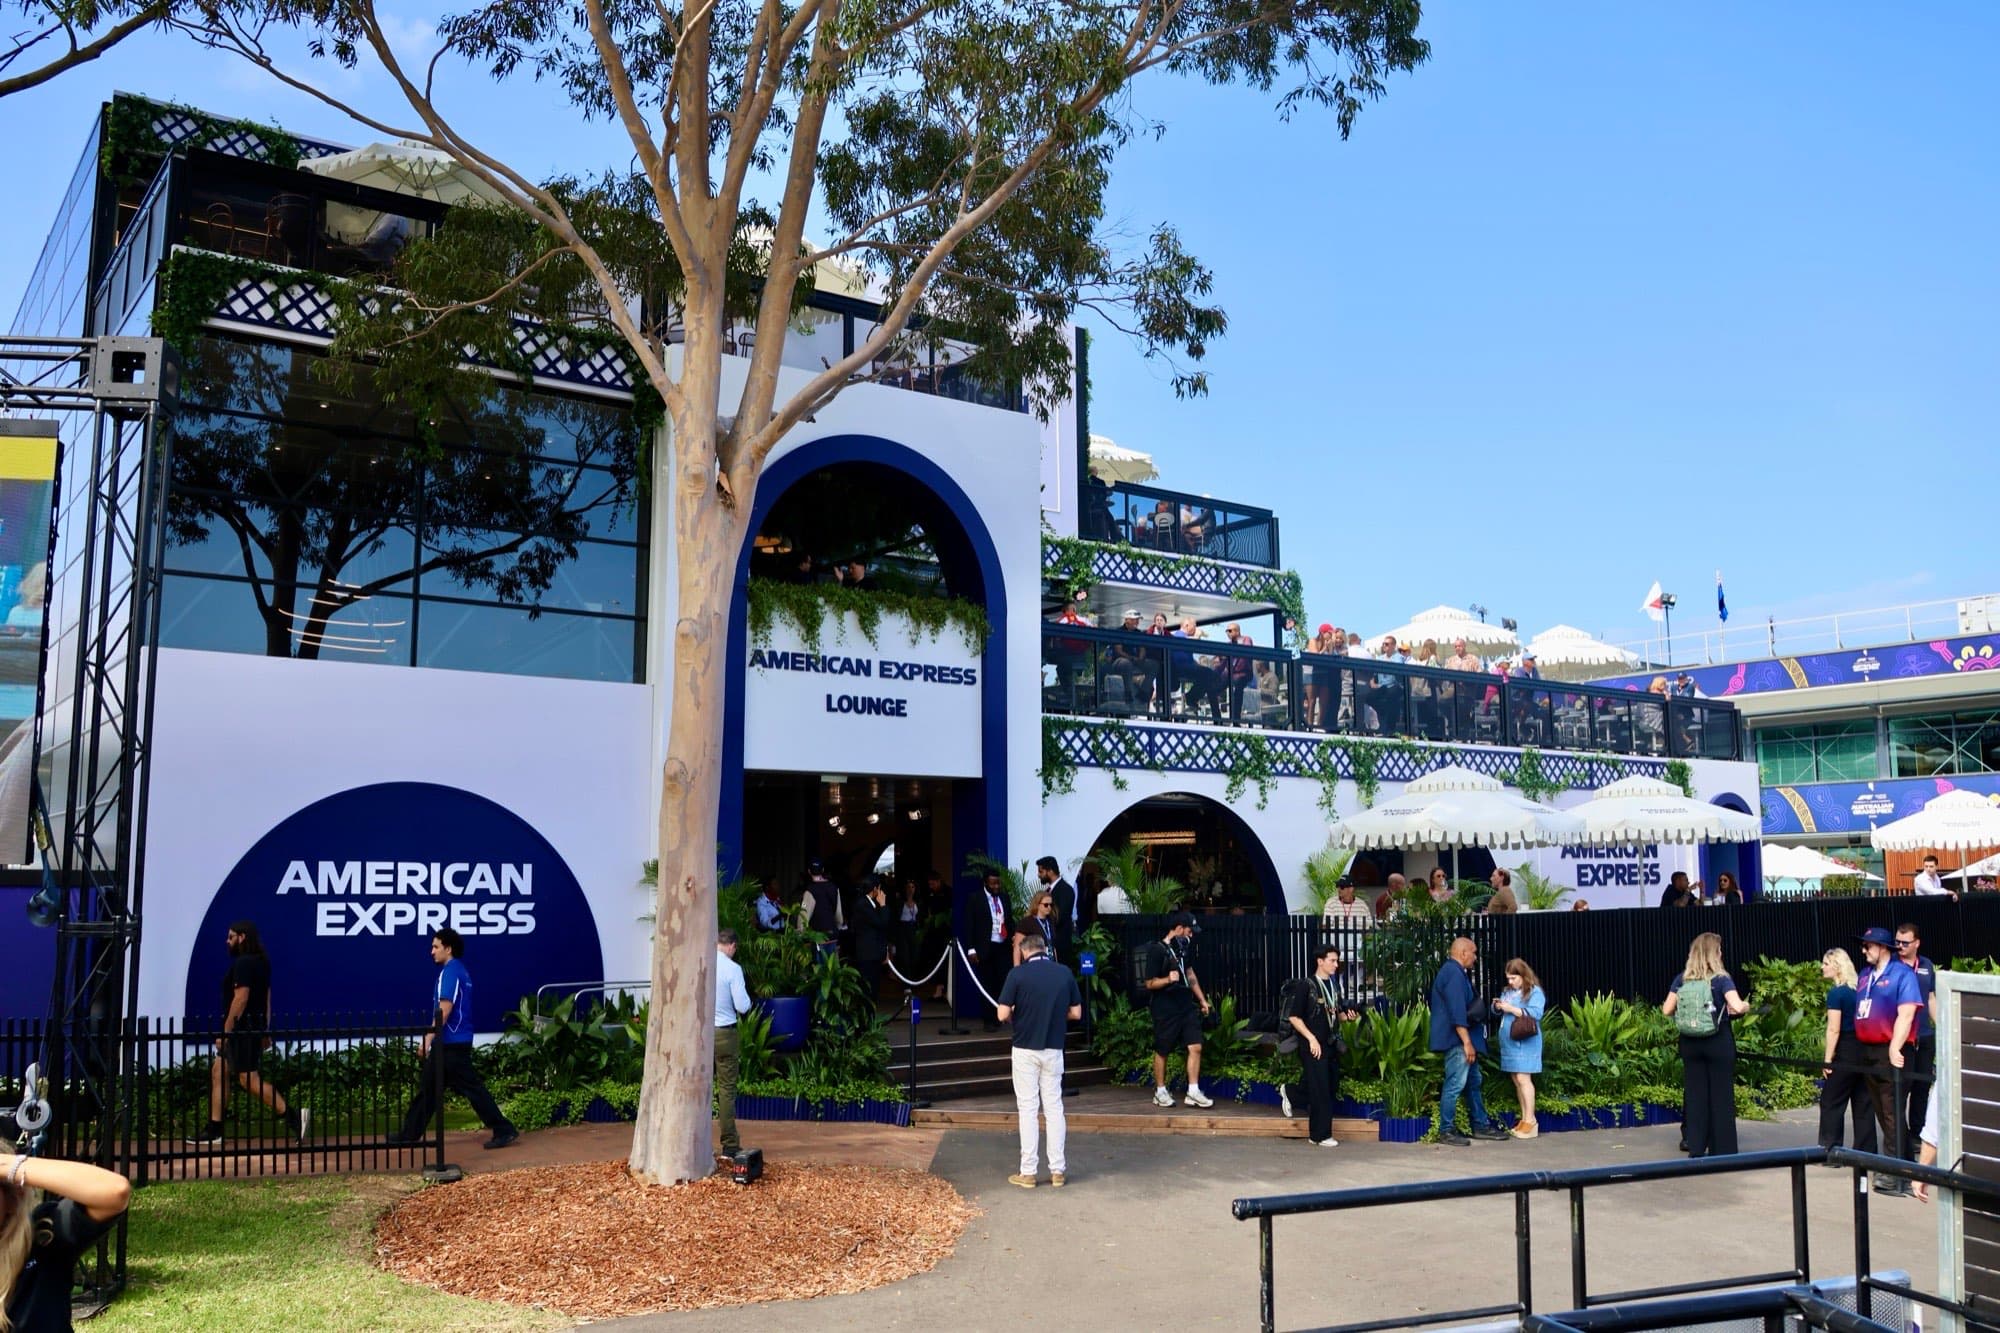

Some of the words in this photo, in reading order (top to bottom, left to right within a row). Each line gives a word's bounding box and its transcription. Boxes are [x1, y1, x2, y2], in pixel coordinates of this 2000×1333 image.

[748, 649, 872, 677] AMERICAN
[879, 660, 977, 686] EXPRESS
[826, 693, 908, 718] LOUNGE
[275, 860, 533, 896] AMERICAN
[1576, 863, 1661, 887] EXPRESS
[316, 902, 536, 936] EXPRESS
